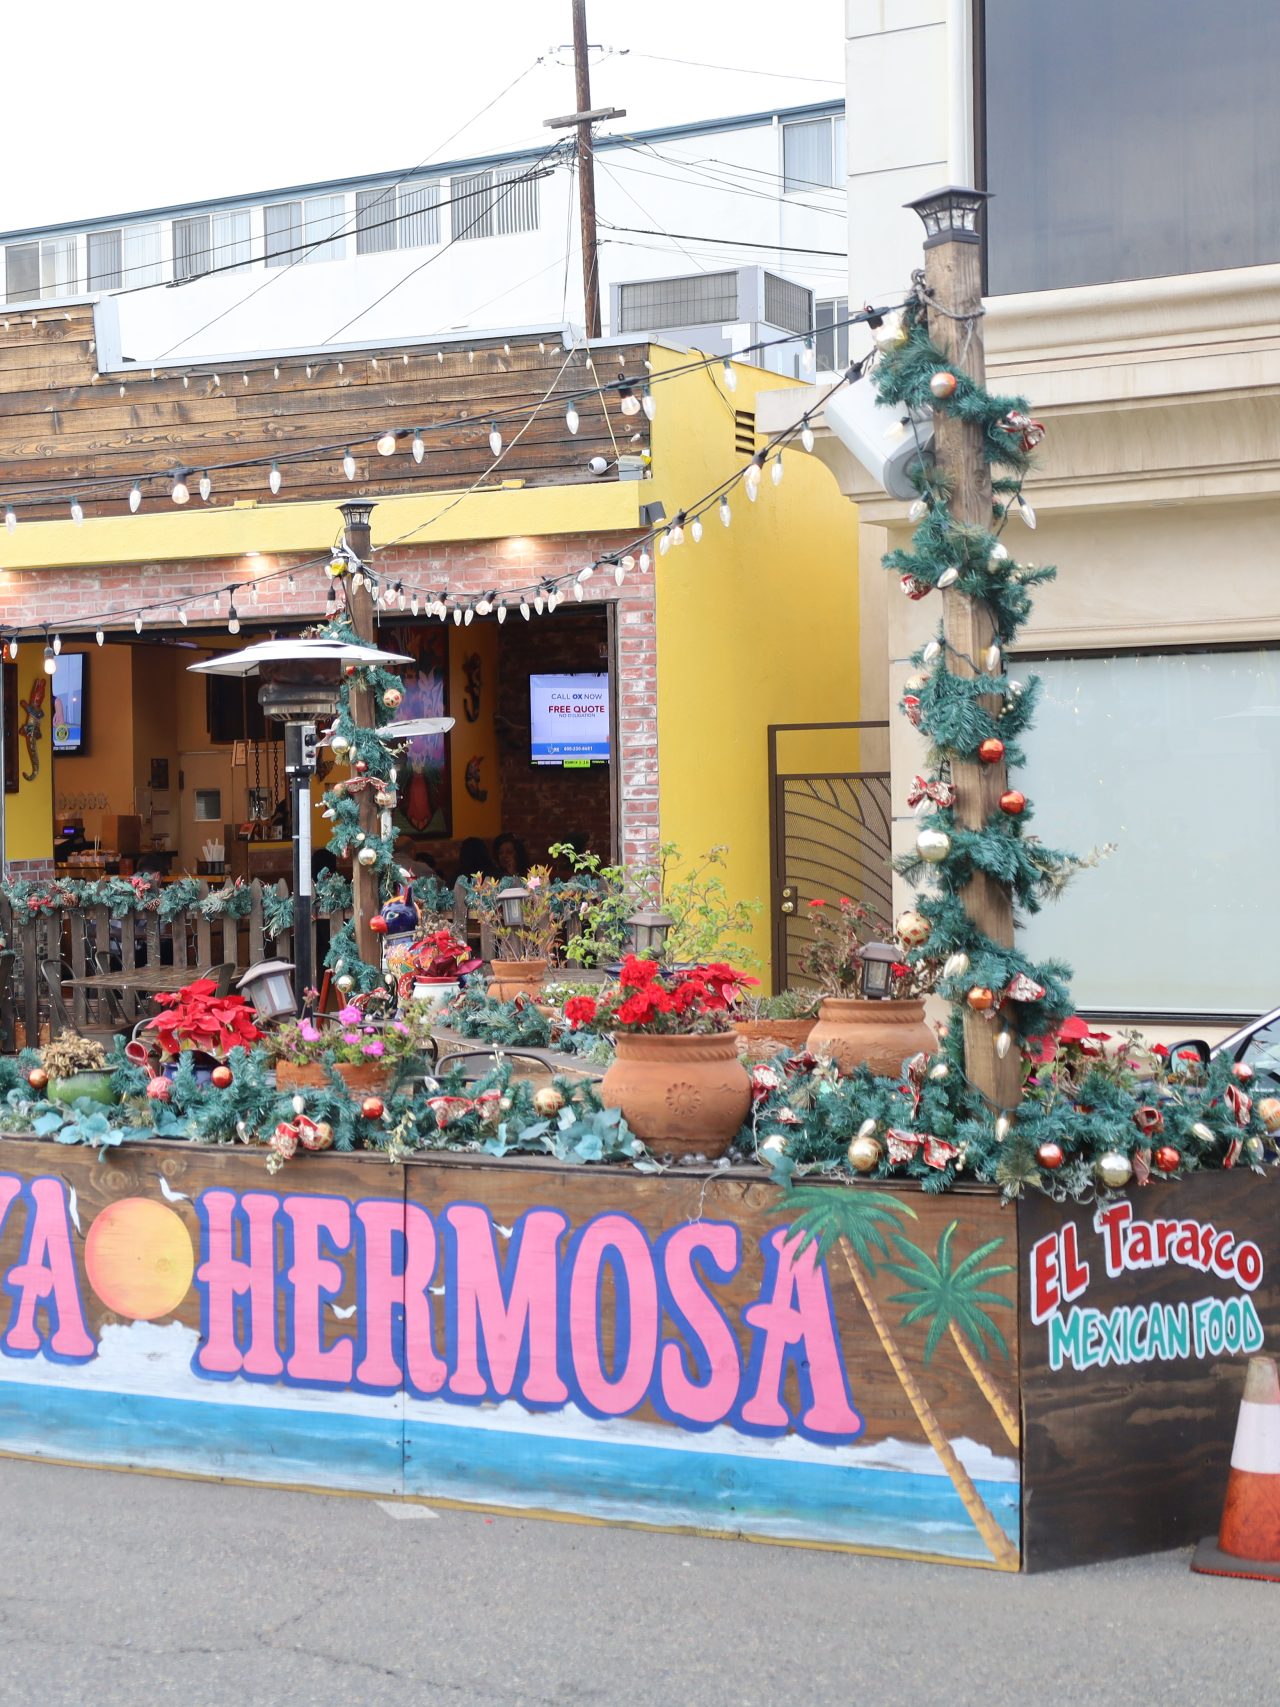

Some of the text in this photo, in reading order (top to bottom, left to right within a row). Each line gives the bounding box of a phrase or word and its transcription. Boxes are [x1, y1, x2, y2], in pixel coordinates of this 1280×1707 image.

[548, 705, 605, 713] FREE QUOTE
[1093, 1201, 1263, 1290] Tarasco
[192, 1187, 865, 1443] HERMOSA
[1049, 1294, 1264, 1371] MEXICAN FOOD
